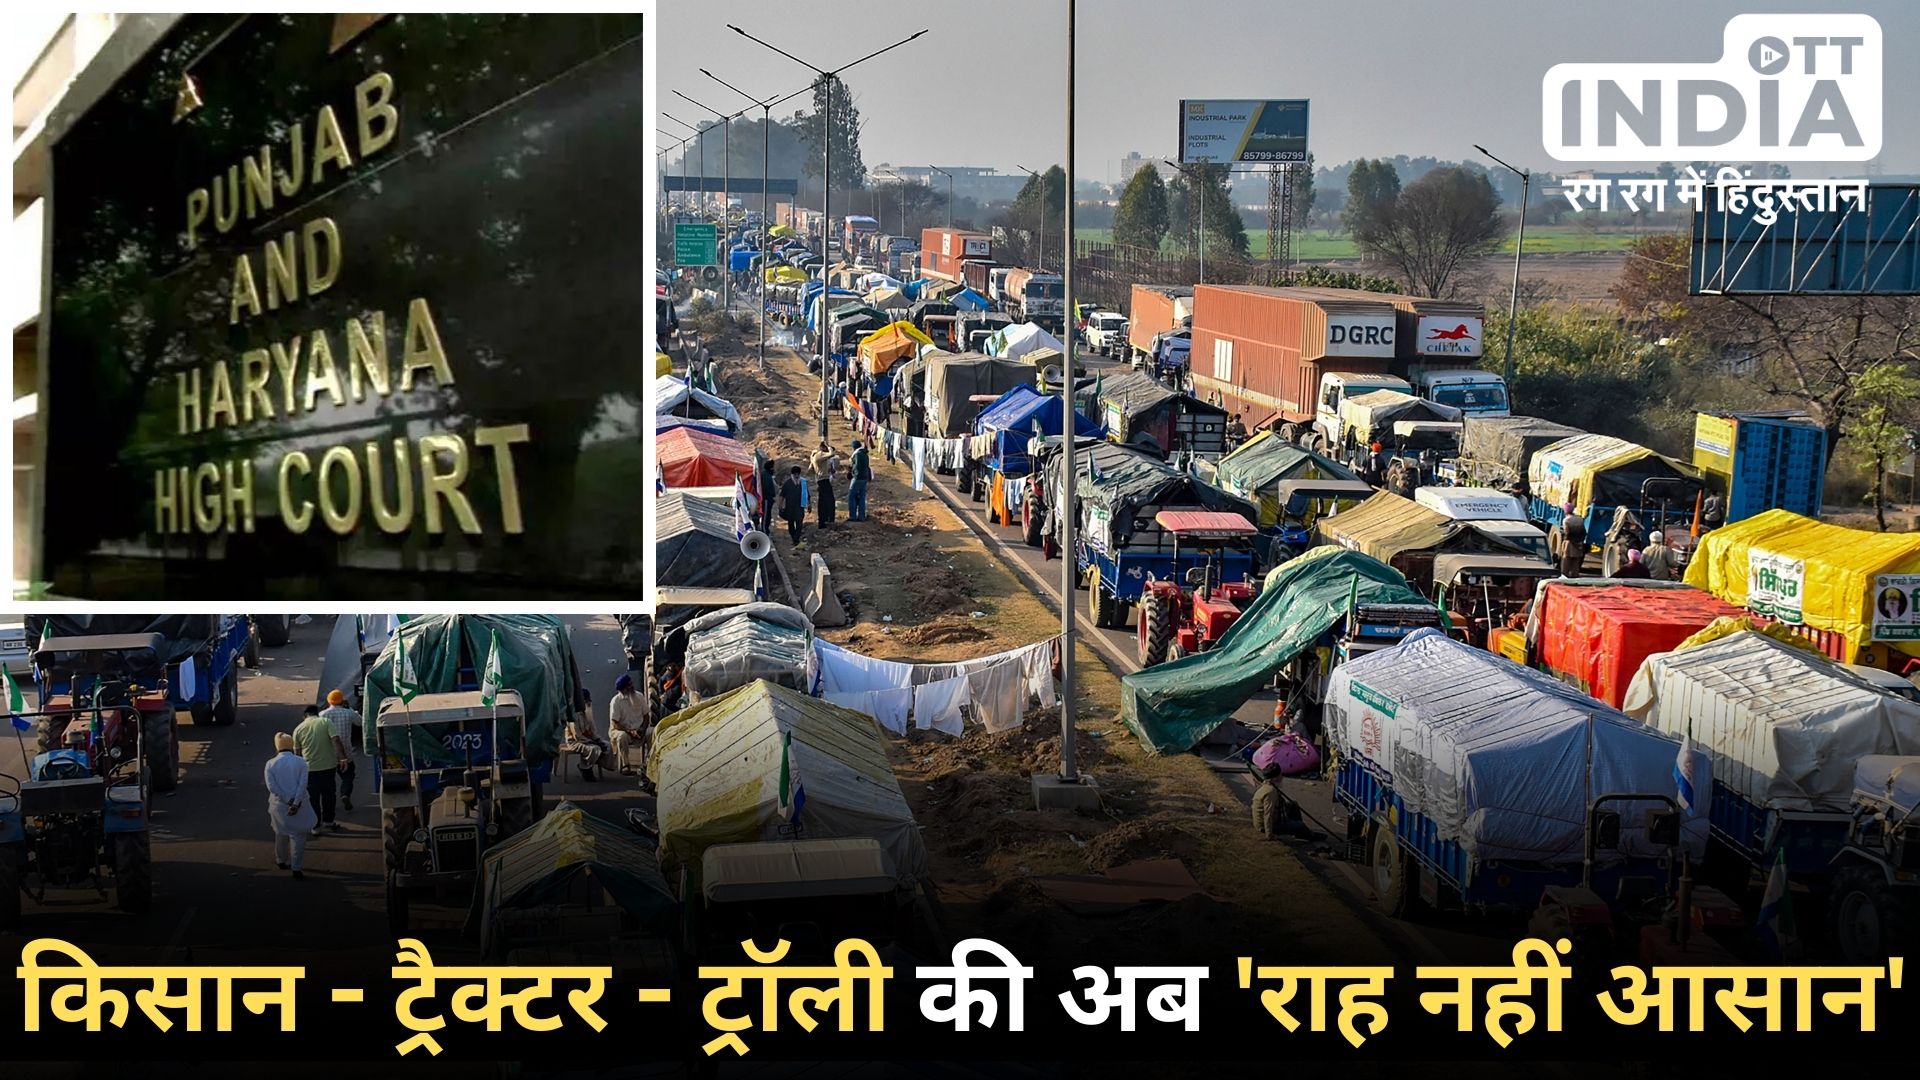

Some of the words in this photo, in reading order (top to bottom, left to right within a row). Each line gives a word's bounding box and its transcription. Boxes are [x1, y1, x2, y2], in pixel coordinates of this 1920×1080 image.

[184, 71, 400, 247] PUNJAB
[1243, 151, 1304, 160] 85799-86799
[229, 216, 343, 325] AND
[175, 297, 455, 434] HARYANA
[1330, 325, 1394, 345] DGRC
[1426, 345, 1472, 353] CHETAK
[154, 459, 256, 534] HIGH
[277, 424, 530, 535] COURT
[442, 733, 482, 750] 2023
